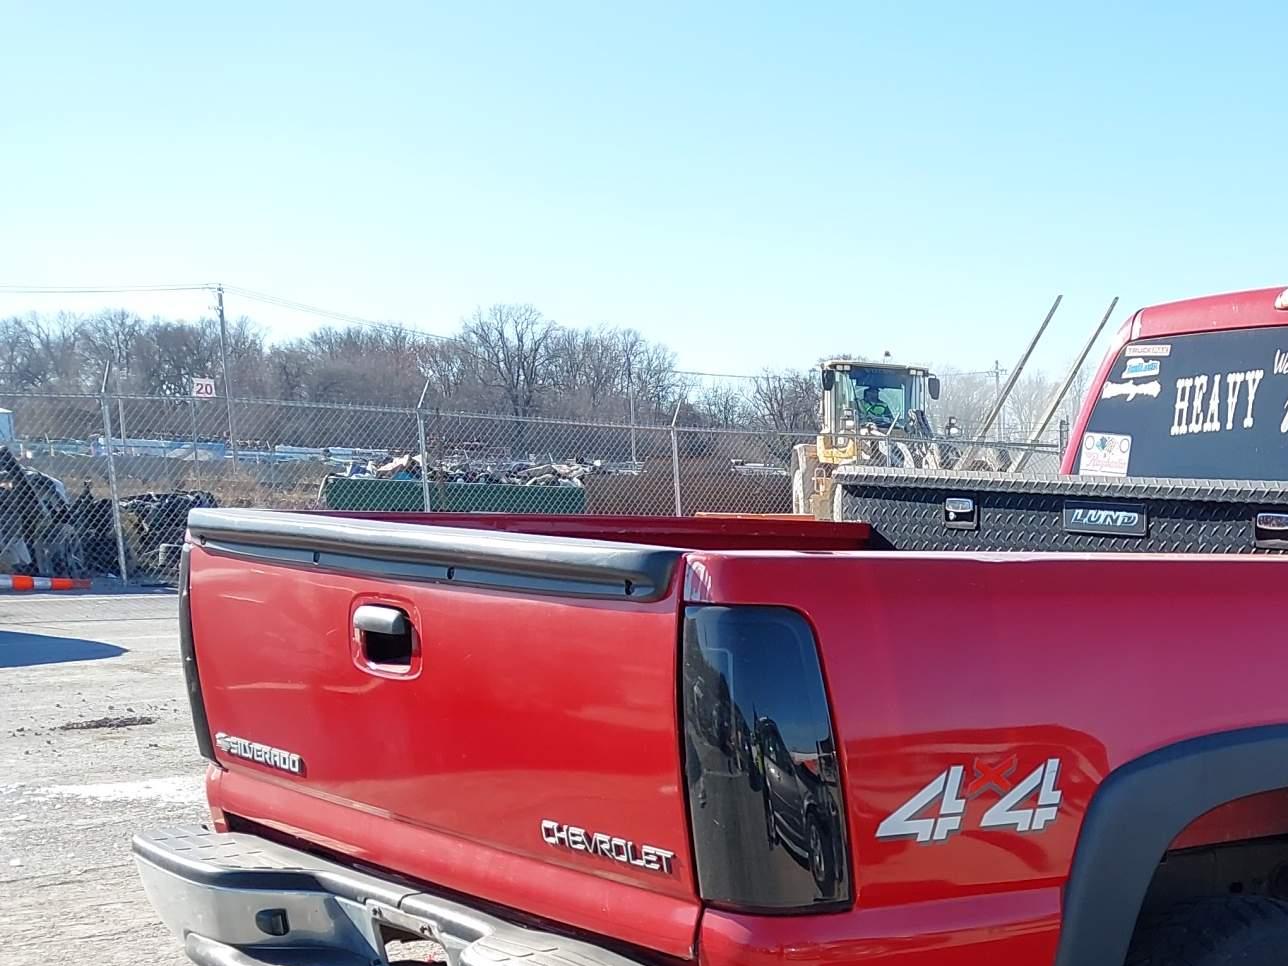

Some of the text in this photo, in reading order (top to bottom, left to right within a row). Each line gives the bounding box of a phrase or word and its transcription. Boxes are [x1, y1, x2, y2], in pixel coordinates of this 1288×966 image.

[196, 383, 213, 396] 20
[1170, 369, 1265, 436] HEAVY
[1071, 509, 1139, 526] LUND
[229, 736, 301, 773] SILVERADO
[541, 819, 675, 874] CHEVROLET
